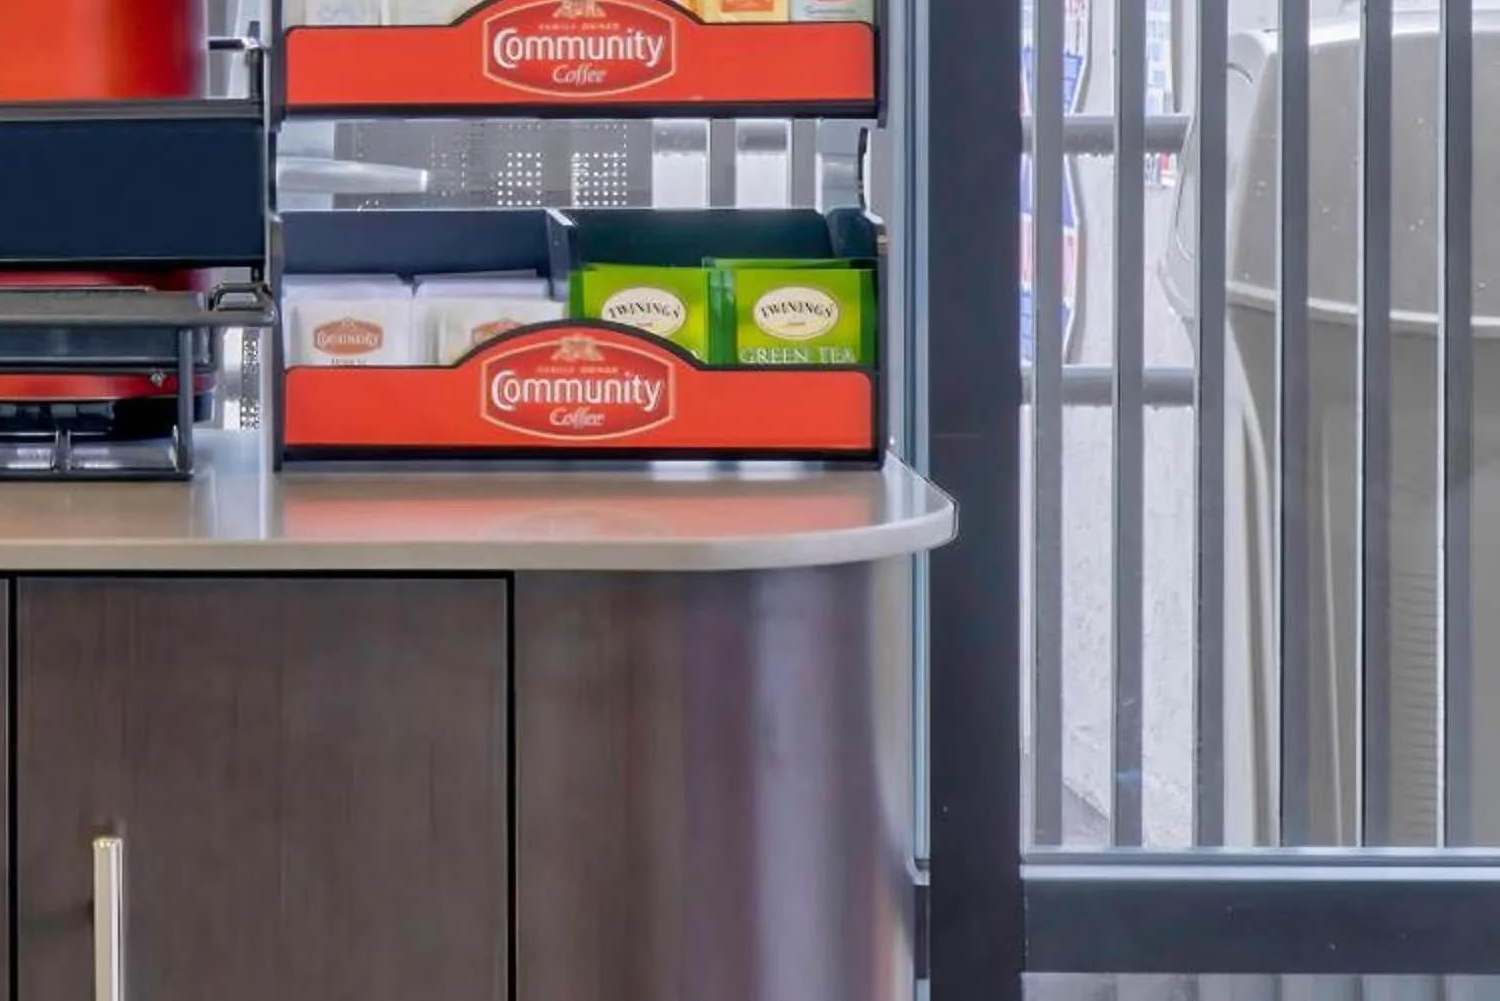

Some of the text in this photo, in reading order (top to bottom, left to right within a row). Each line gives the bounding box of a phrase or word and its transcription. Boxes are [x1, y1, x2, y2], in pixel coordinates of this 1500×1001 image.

[493, 27, 664, 69] Community
[552, 63, 608, 86] Coffee
[608, 302, 681, 319] TWININGS
[760, 300, 833, 319] TWININGS
[739, 347, 857, 364] GREEN TEA
[491, 369, 663, 412] Community
[550, 406, 605, 428] Coffee
